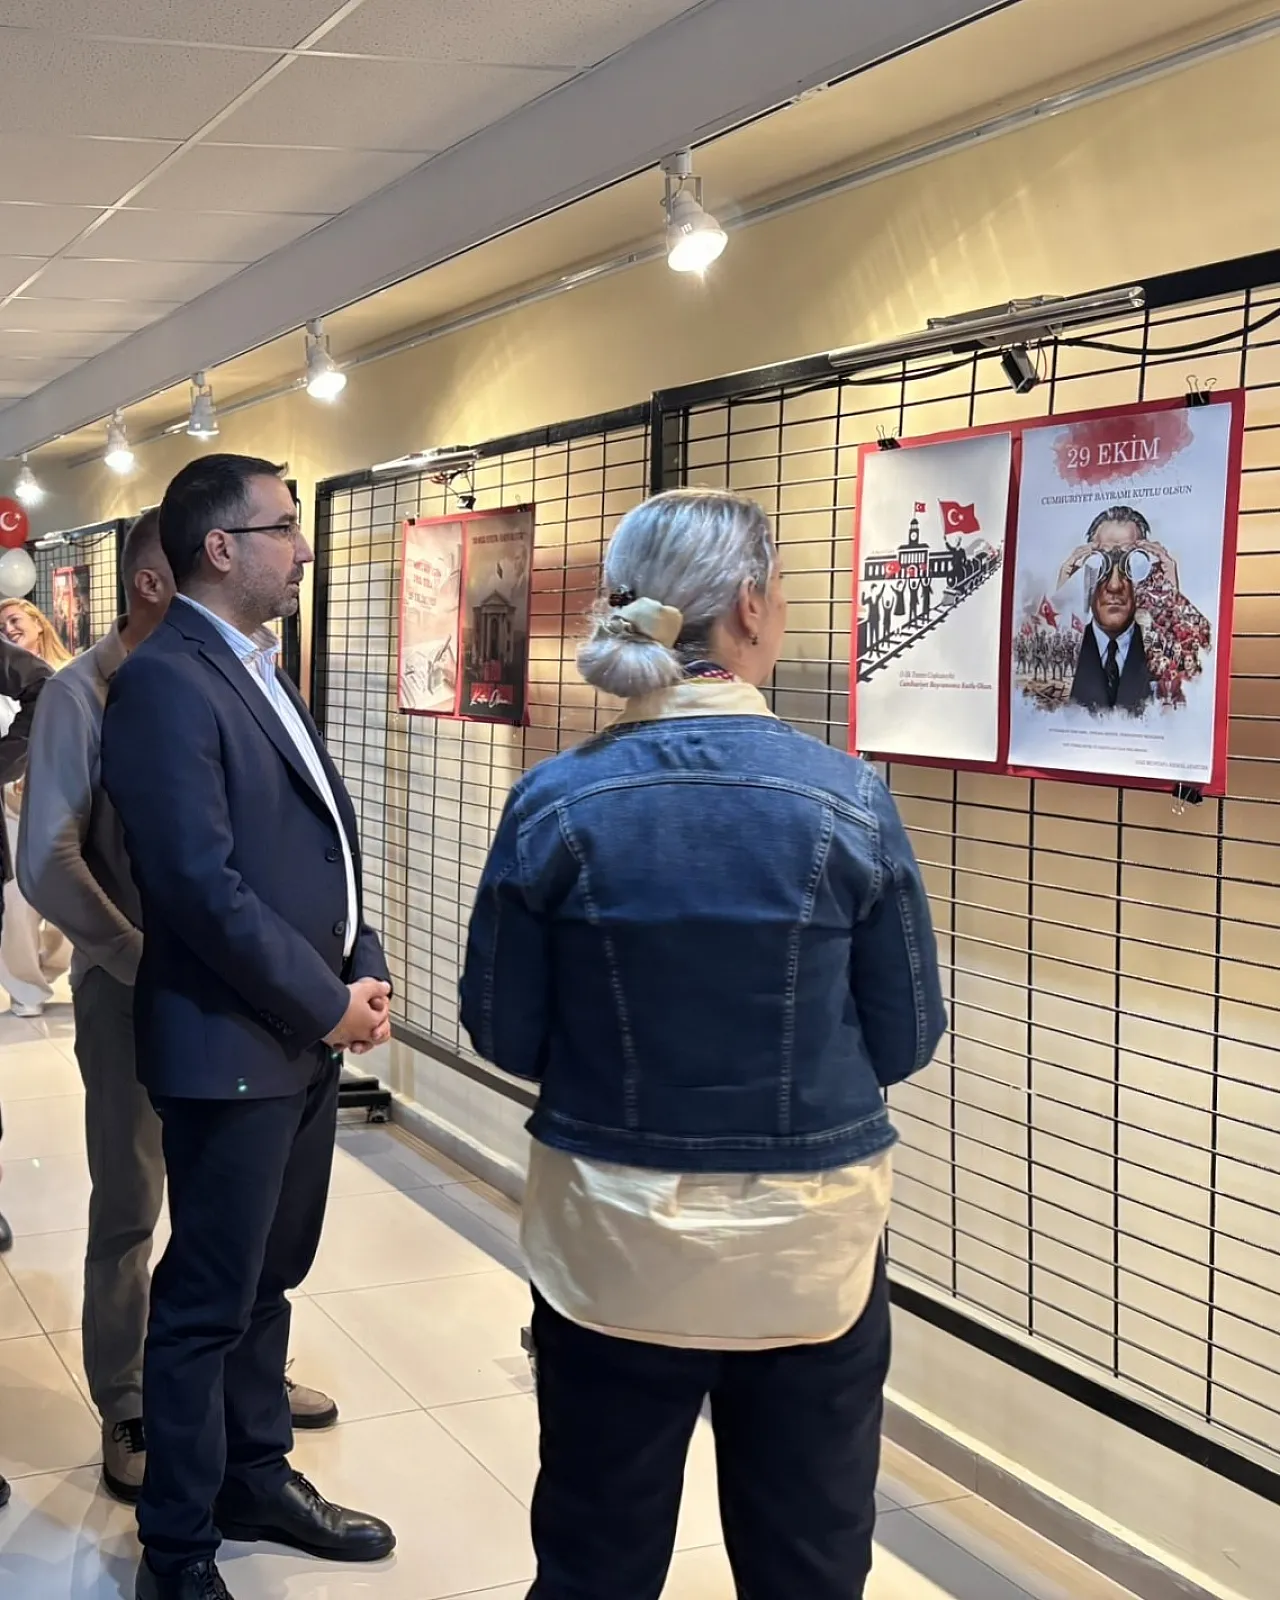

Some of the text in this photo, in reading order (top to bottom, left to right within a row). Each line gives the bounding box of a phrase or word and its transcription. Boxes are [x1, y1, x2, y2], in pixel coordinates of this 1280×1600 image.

[1067, 434, 1161, 469] 29 EKİM
[1132, 487, 1161, 498] KUTLU
[1162, 485, 1193, 496] OLSUN
